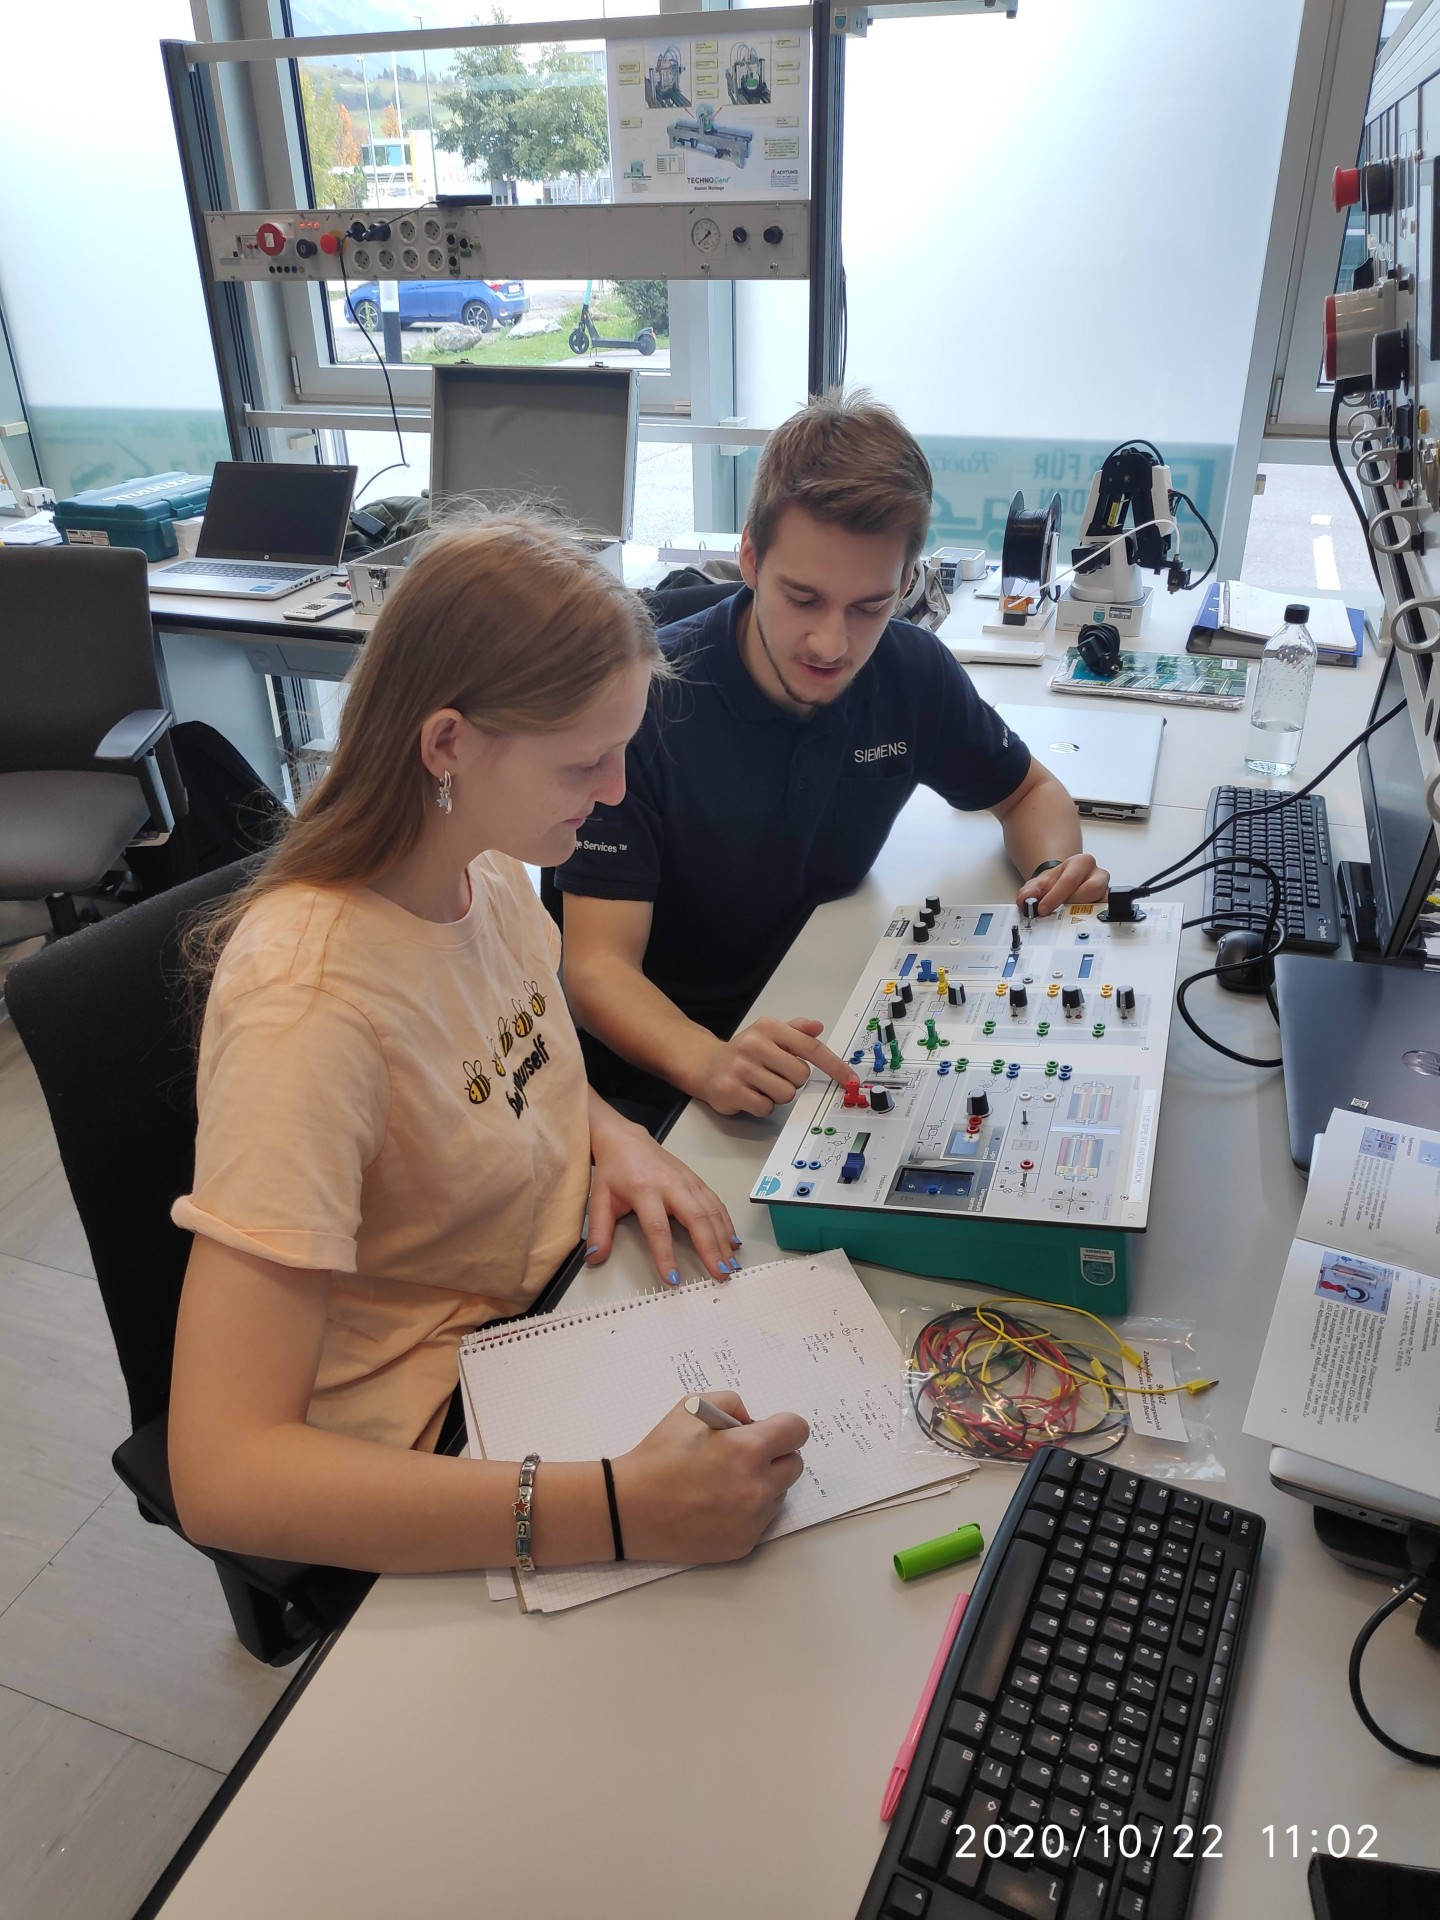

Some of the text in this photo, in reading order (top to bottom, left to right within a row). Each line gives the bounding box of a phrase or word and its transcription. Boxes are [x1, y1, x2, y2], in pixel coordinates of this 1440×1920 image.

[102, 477, 201, 502] makita
[854, 741, 907, 764] SIEMENS
[583, 840, 617, 853] Services
[512, 1033, 550, 1109] yourself
[975, 1187, 986, 1212] Temperature
[1077, 1646, 1087, 1654] H
[1029, 1675, 1039, 1684] M
[1106, 1682, 1114, 1690] U
[1059, 1704, 1069, 1712] K
[1088, 1743, 1097, 1751] O
[1081, 1775, 1089, 1783] P
